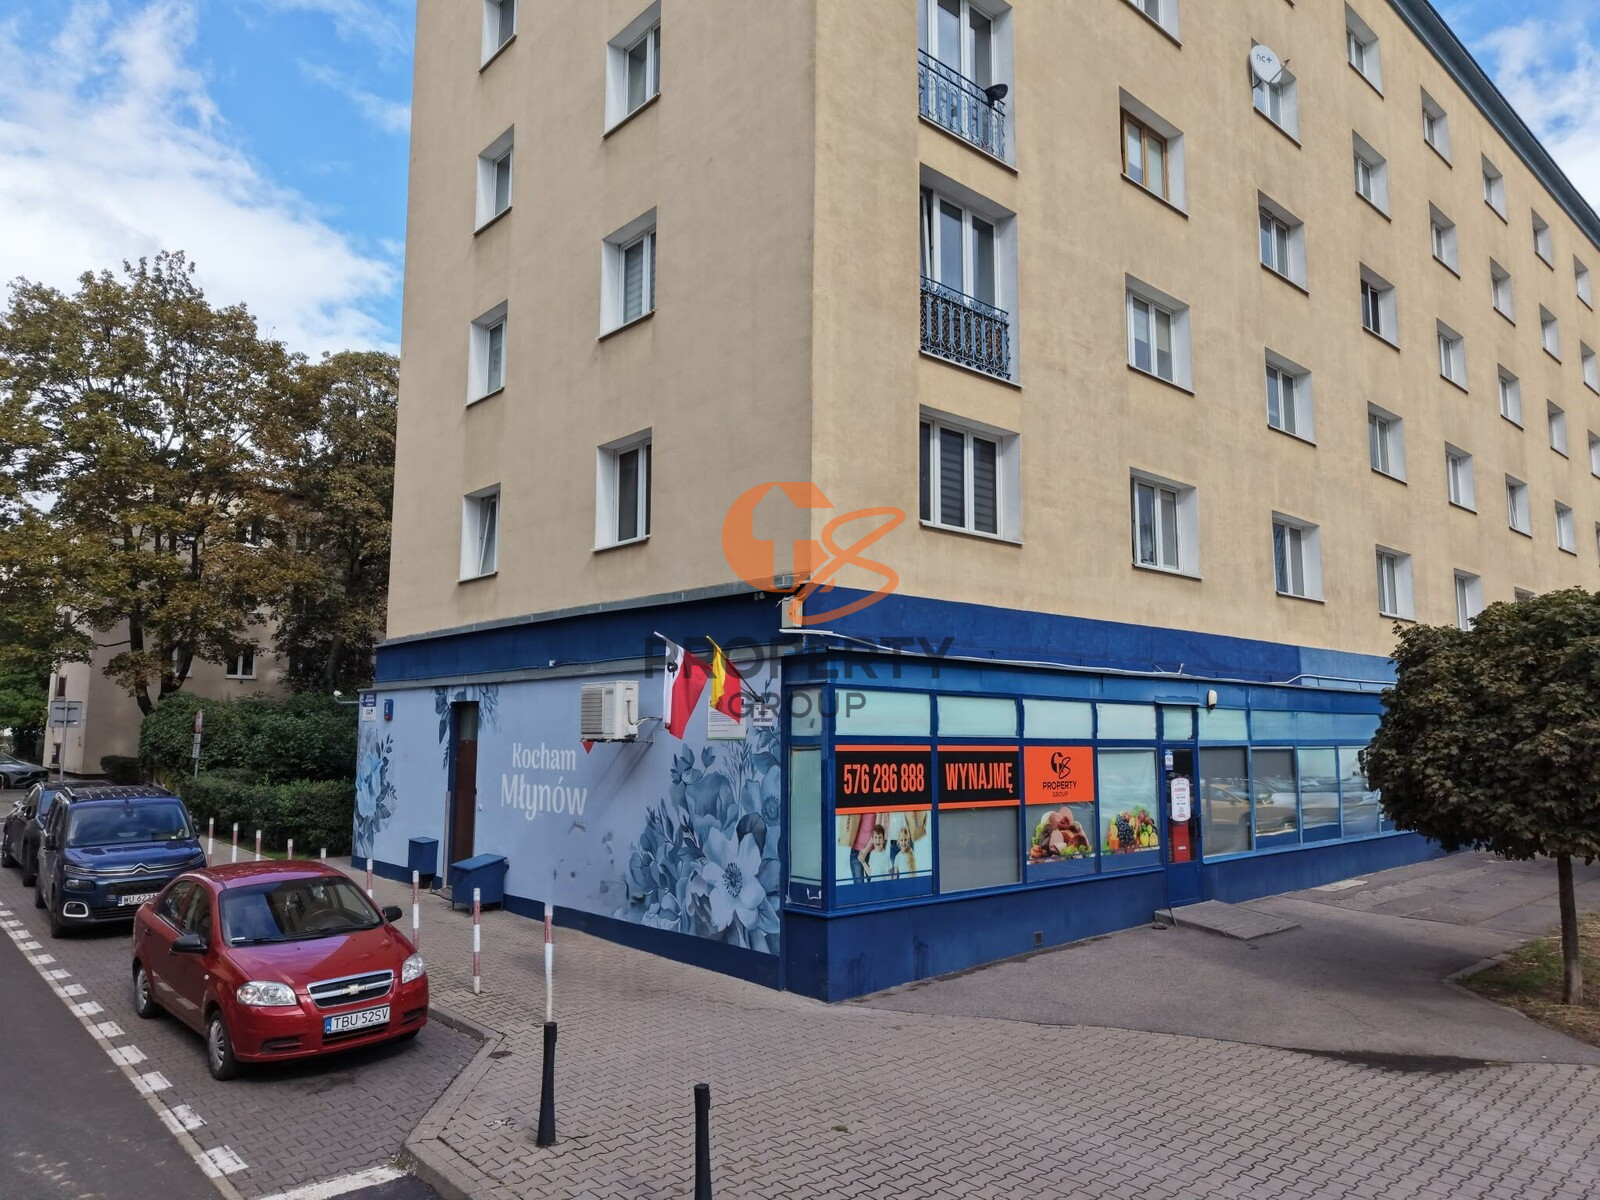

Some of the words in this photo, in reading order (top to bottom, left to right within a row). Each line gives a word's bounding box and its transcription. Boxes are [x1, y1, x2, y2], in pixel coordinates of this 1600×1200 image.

[1256, 53, 1272, 64] nc+
[512, 742, 576, 771] Kocham
[843, 763, 870, 795] 576
[872, 763, 898, 793] 286
[900, 763, 925, 792] 888
[945, 762, 1013, 794] WYNAJMĘ
[1042, 781, 1077, 790] PROPERTY
[501, 773, 588, 821] Młynów
[123, 895, 135, 904] WU
[334, 1014, 359, 1029] TBU
[361, 1007, 389, 1024] 52SV
